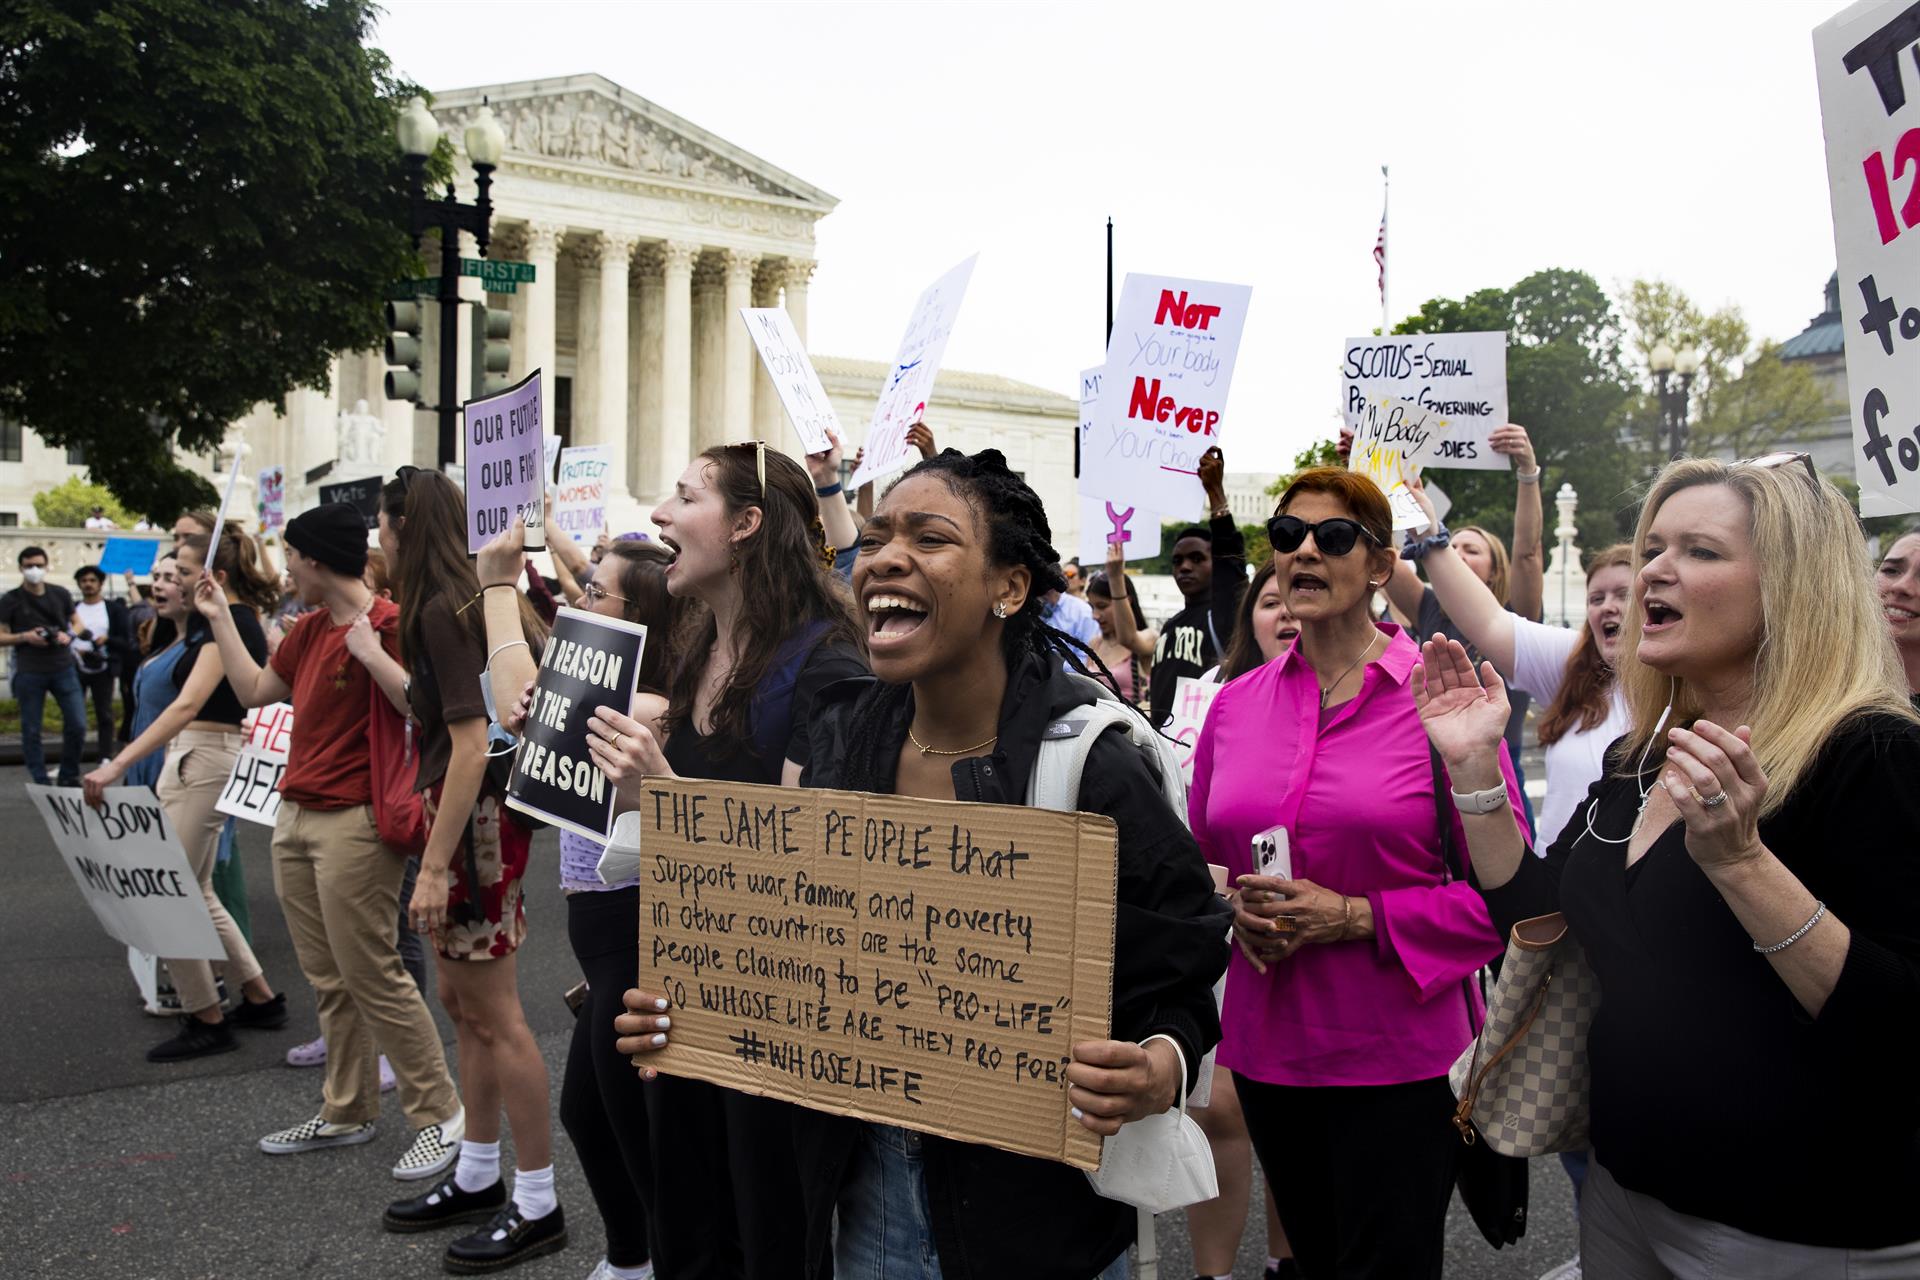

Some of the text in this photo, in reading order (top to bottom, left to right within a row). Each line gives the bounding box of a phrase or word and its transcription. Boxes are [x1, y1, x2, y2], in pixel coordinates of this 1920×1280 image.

[1842, 0, 1920, 117] T
[466, 261, 520, 280] FIRST
[483, 281, 515, 292] UNIT
[1858, 274, 1920, 356] to
[1085, 375, 1102, 397] M
[1183, 339, 1220, 387] body
[474, 414, 504, 446] OUR
[1383, 406, 1430, 459] Body
[1434, 441, 1478, 459] DIES
[481, 459, 513, 490] OUR
[519, 449, 537, 483] FIT
[561, 460, 608, 483] PROTECT
[1160, 441, 1201, 471] Choic
[477, 506, 508, 536] OUR
[553, 639, 623, 691] REASON
[1167, 626, 1204, 668] OR
[528, 686, 572, 732] S THE
[520, 740, 606, 804] REASON
[46, 794, 166, 841] MY BODY
[649, 789, 1029, 880] THE SAME PEOPLE that
[76, 857, 187, 899] MY CHOICE
[747, 873, 788, 906] war,
[794, 871, 858, 919] famine,
[868, 890, 914, 921] and
[926, 905, 1033, 954] poverty
[651, 894, 1024, 983] in other countries are the same
[834, 958, 859, 995] to
[875, 968, 910, 1010] be
[663, 976, 1071, 1089] SO WHOSE LIFE ARE THEY PRO FOR?
[729, 1029, 923, 1105] #WHOSELIFE
